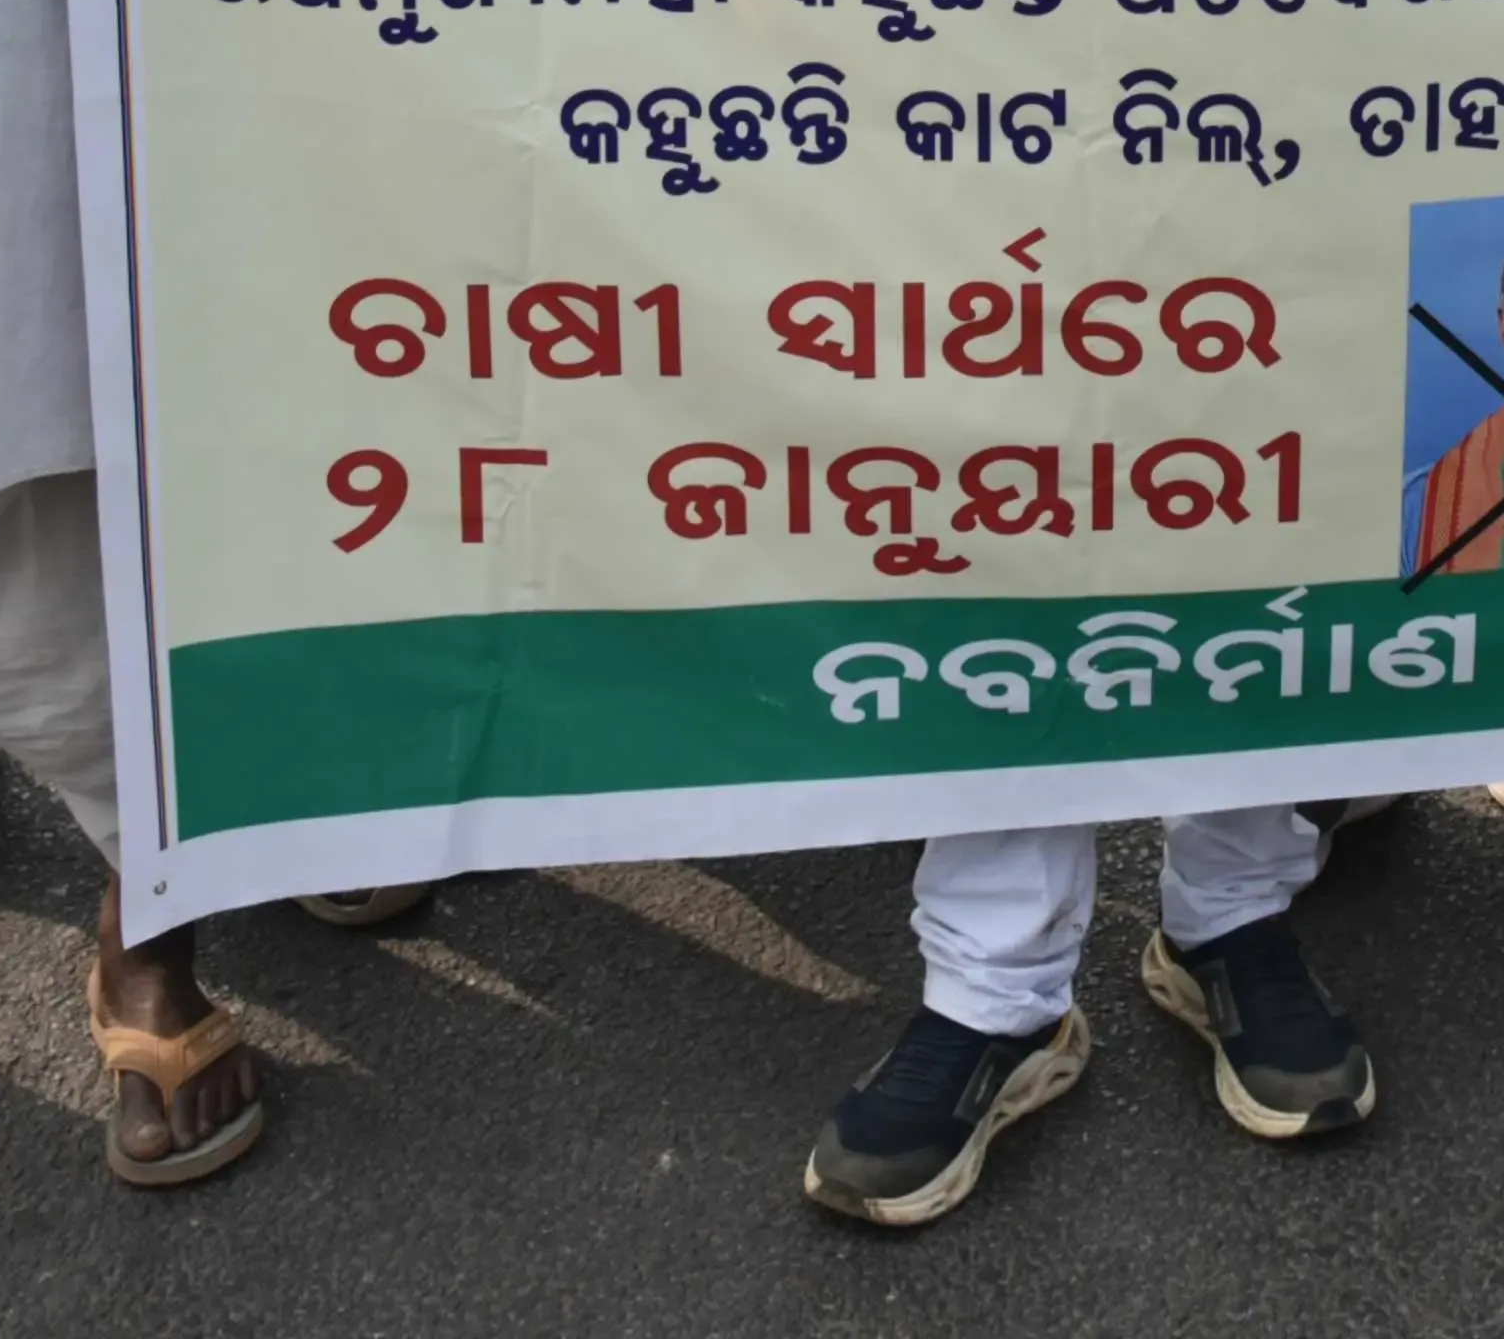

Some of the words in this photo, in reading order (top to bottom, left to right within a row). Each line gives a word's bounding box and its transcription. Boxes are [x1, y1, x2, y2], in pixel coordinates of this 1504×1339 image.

[559, 61, 850, 196] କହୁଛନ୍ତି
[895, 87, 1068, 164] କାଟ
[327, 276, 683, 380] ଚାଷୀ
[646, 430, 1302, 576] ଜାନୁୟାରୀ
[811, 585, 1478, 723] ନବନିର୍ମାଣ
